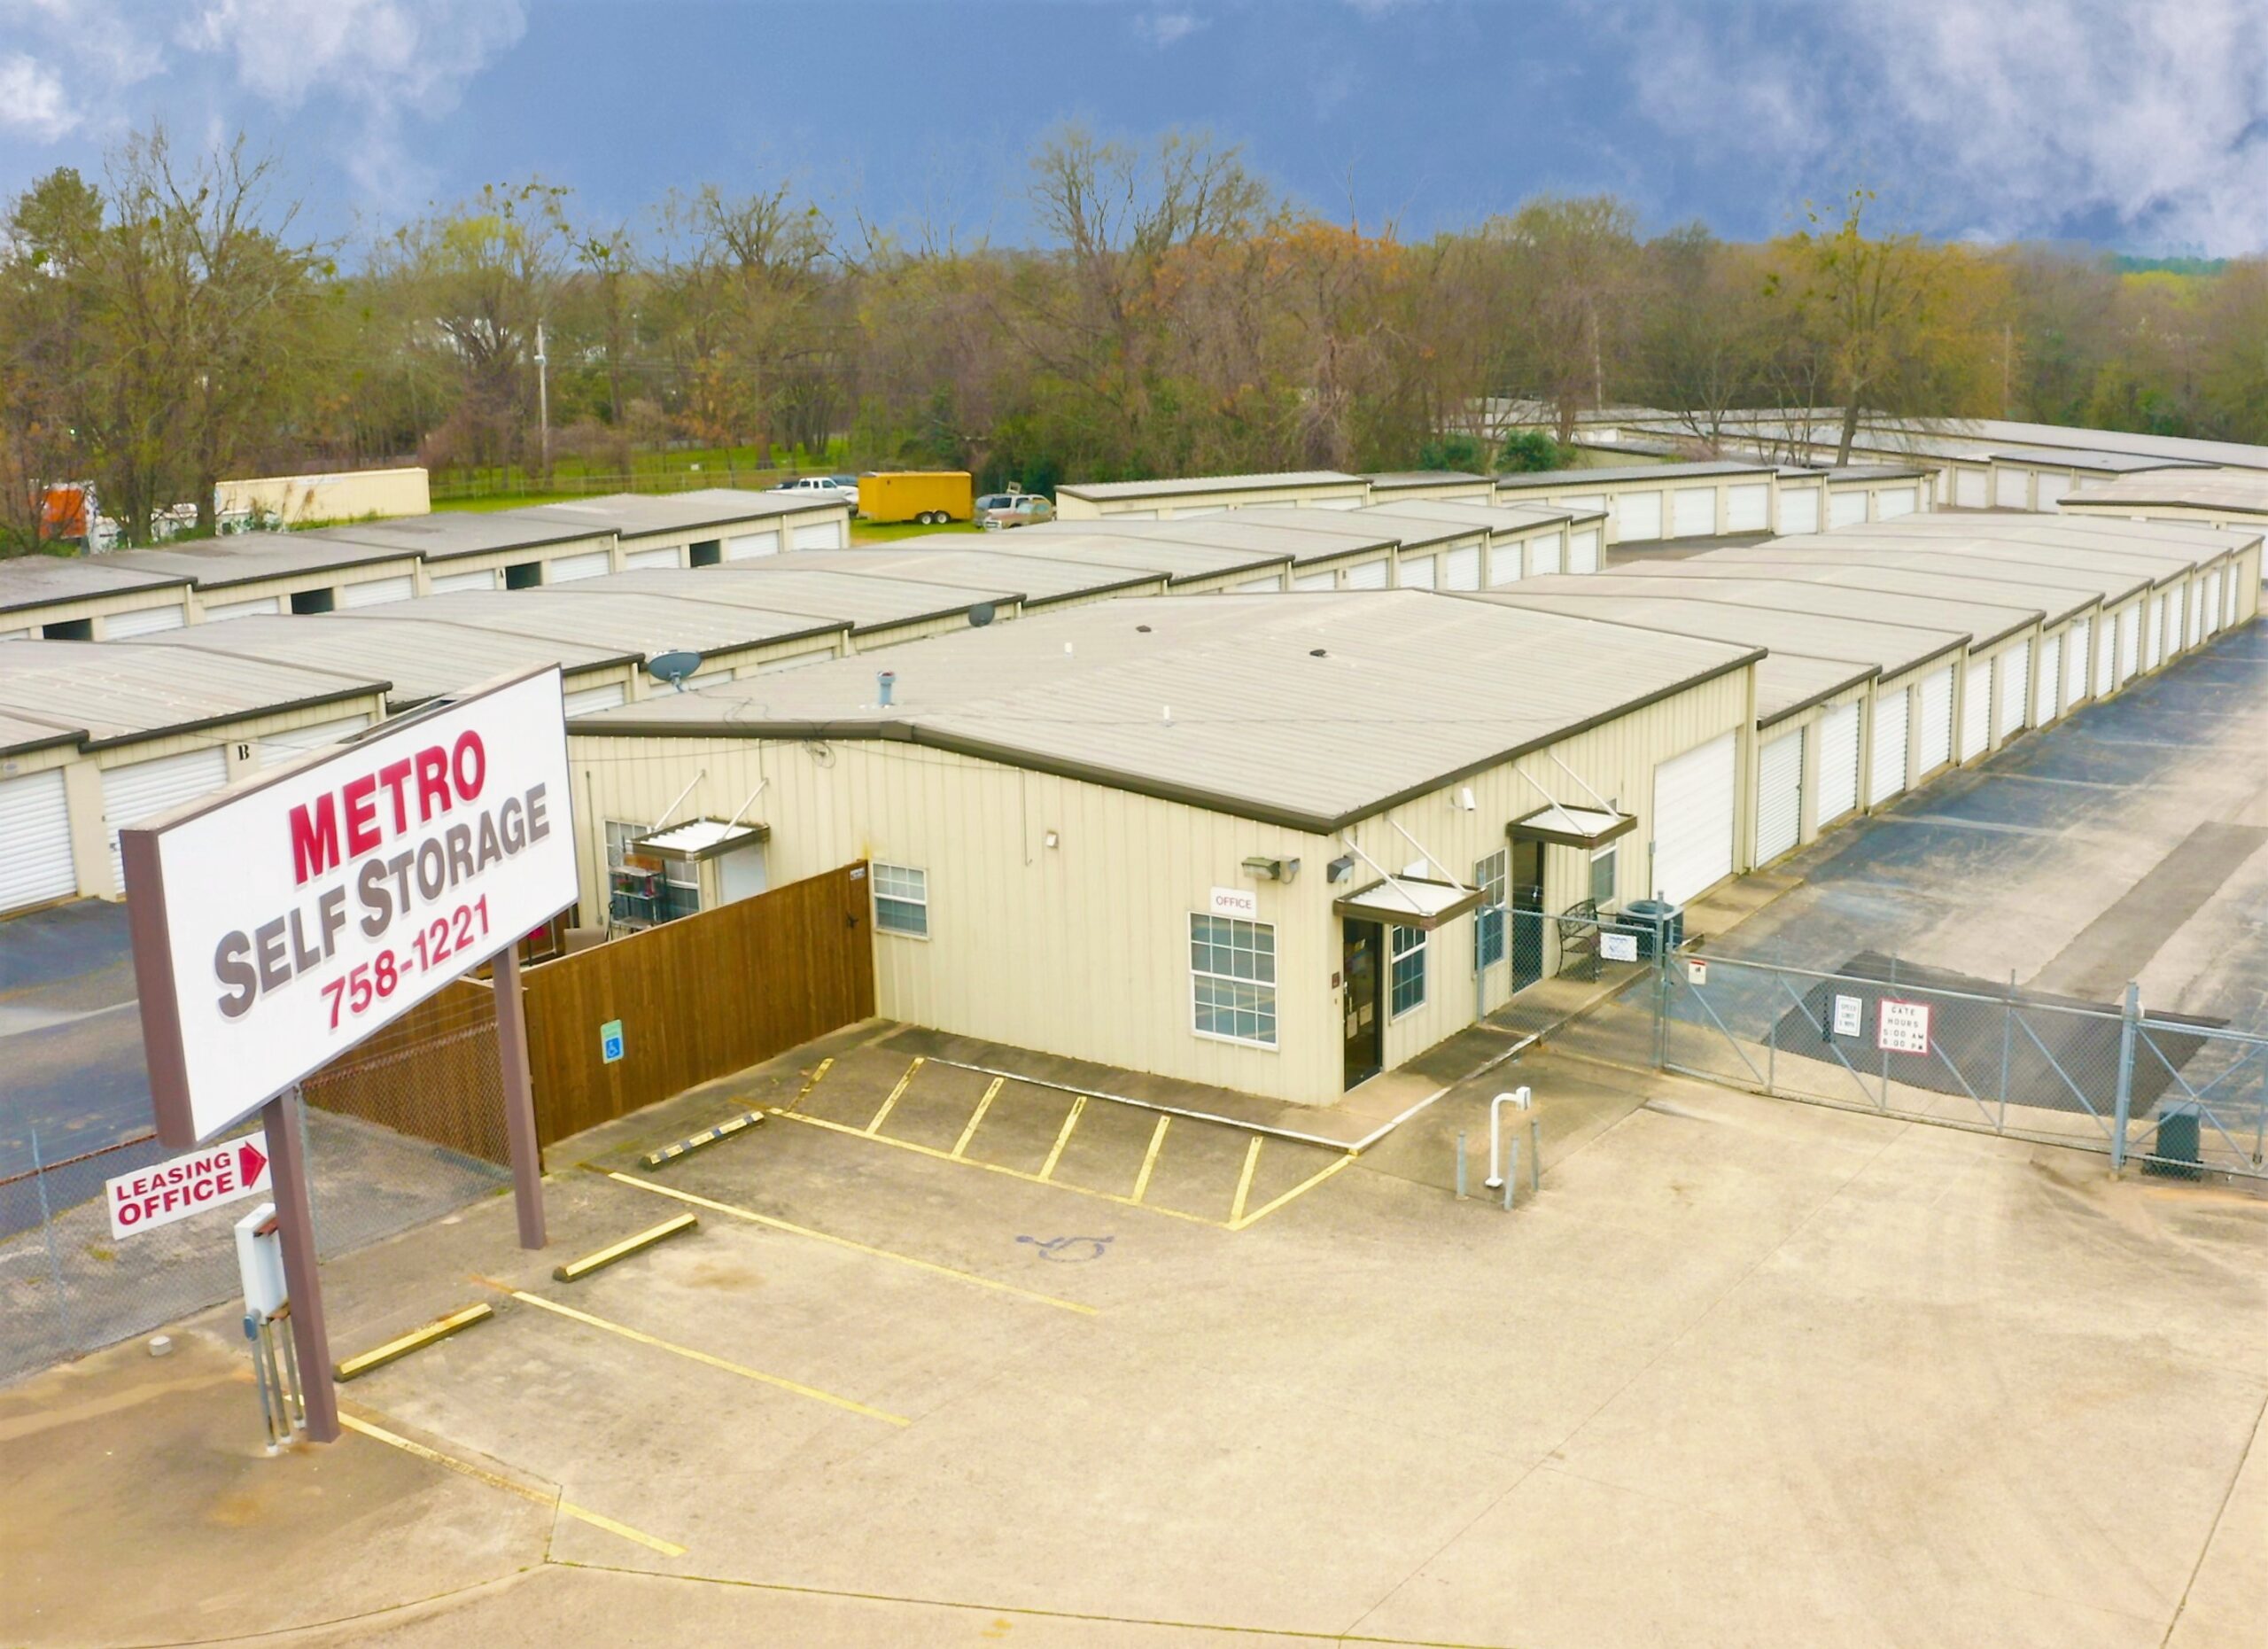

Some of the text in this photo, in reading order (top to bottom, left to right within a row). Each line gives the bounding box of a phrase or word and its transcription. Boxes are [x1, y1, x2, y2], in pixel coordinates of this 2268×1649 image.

[237, 743, 250, 760] B
[289, 729, 486, 885] METRO
[214, 782, 550, 1018] SELF STORAGE
[1216, 895, 1252, 909] OFFICE
[322, 894, 489, 1030] 758-1221
[1887, 1018, 1919, 1029] HOURS
[116, 1152, 231, 1202] LEASING
[118, 1171, 235, 1226] OFFICE
